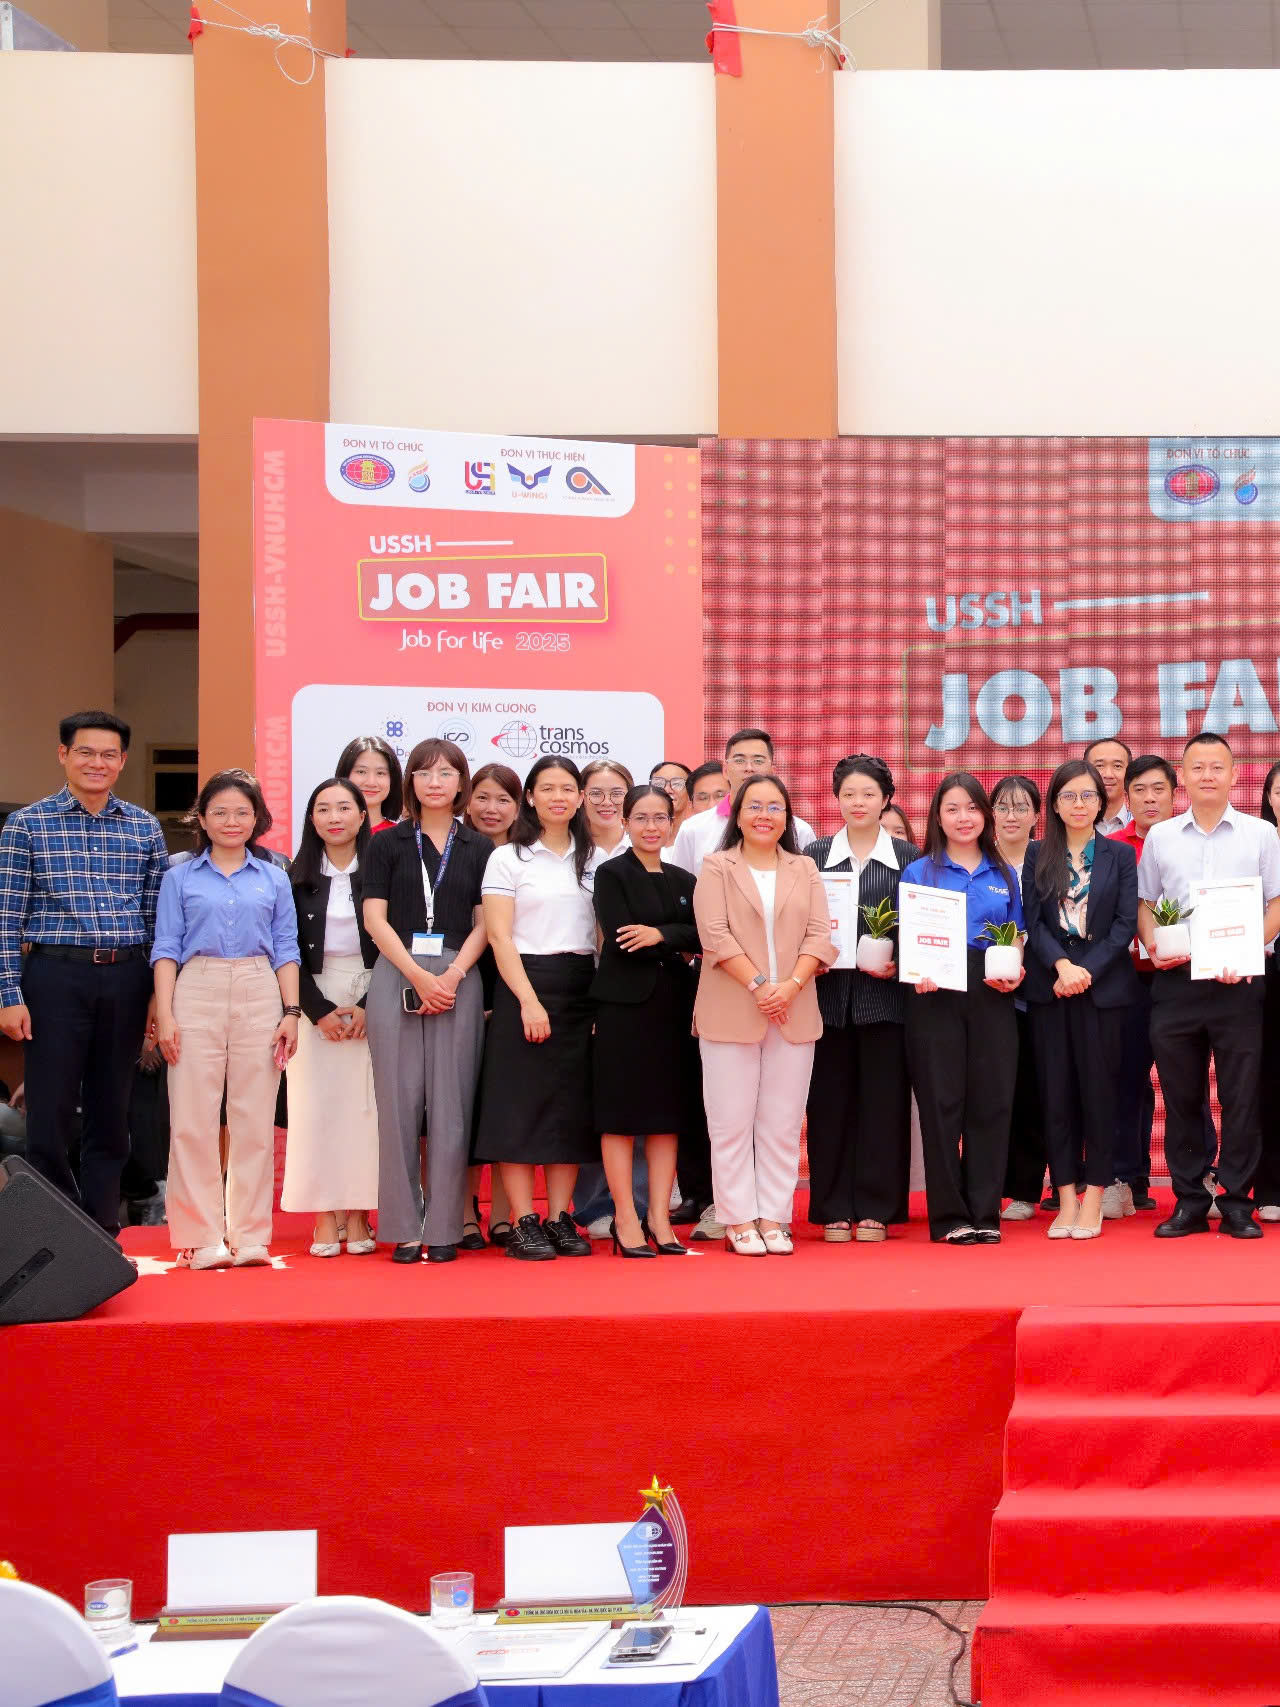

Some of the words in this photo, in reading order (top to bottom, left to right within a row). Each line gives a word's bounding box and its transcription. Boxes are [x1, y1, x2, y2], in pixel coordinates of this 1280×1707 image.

[369, 534, 432, 554] USSH
[369, 572, 471, 611] JOB
[486, 572, 599, 609] FAIR
[925, 589, 1044, 634] USSH
[398, 628, 432, 652] Job
[437, 629, 468, 653] for
[472, 630, 504, 654] life
[515, 631, 571, 652] 2025
[471, 702, 492, 713] KIM
[924, 667, 1124, 751] JOB
[539, 724, 584, 740] trans
[539, 740, 609, 754] cosmos
[918, 936, 934, 945] JOB
[934, 938, 950, 947] FAIR
